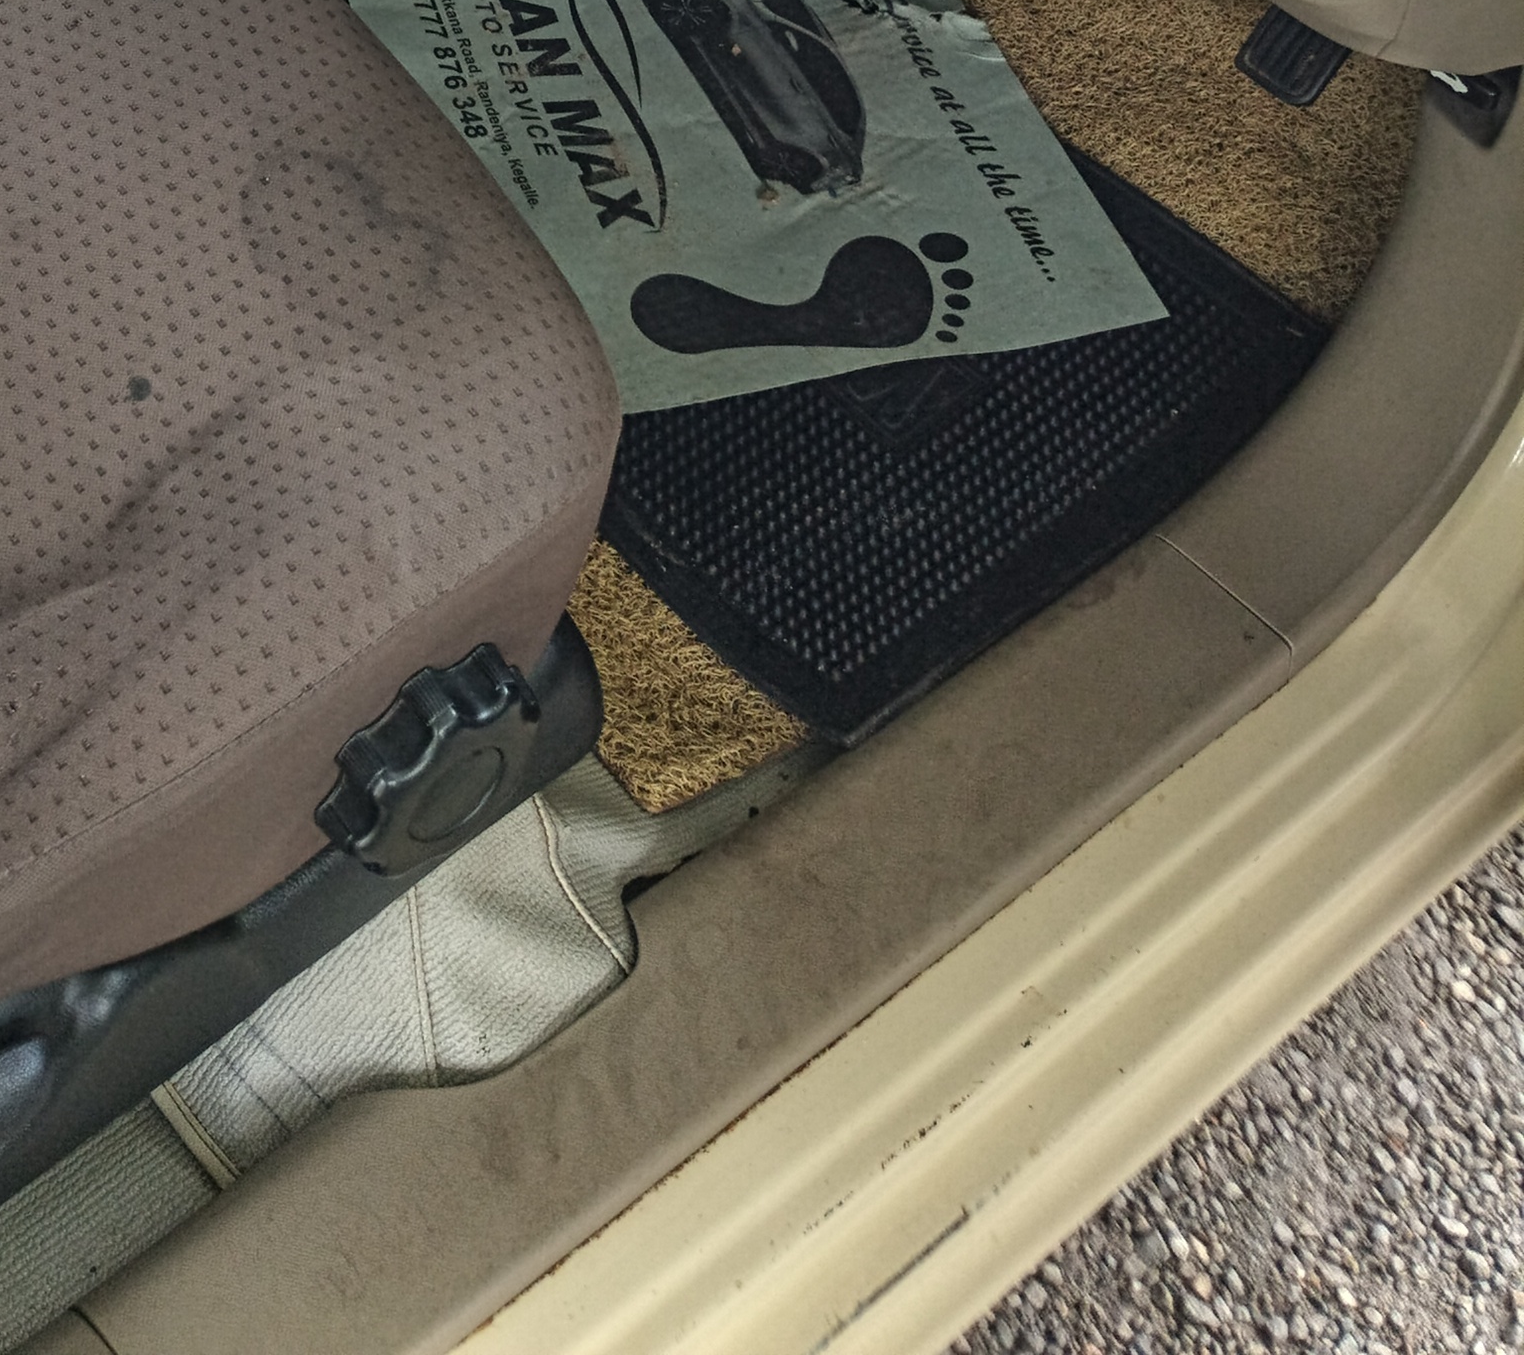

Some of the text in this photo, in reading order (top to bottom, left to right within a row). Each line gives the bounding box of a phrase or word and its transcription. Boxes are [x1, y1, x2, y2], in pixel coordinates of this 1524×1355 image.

[432, 46, 469, 91] 876
[451, 96, 489, 140] 348
[491, 43, 559, 158] SERVICE
[929, 85, 966, 112] at
[949, 118, 998, 156] all
[976, 161, 1022, 200] the
[541, 98, 657, 230] MAX
